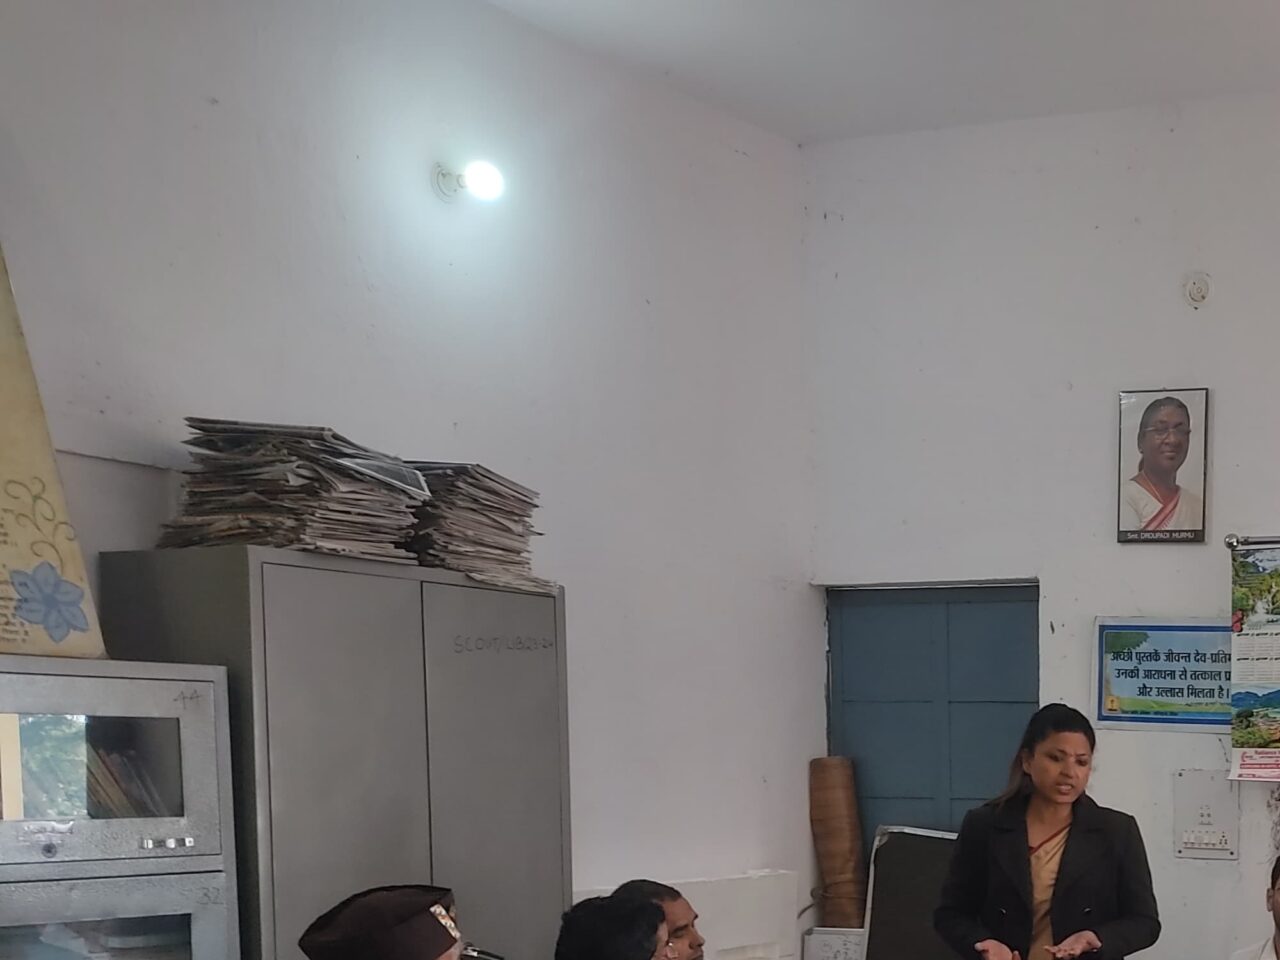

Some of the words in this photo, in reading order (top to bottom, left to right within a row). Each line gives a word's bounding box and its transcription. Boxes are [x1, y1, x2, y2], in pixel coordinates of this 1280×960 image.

[1172, 531, 1195, 539] MURMU
[1111, 649, 1133, 662] अच्छी
[1135, 649, 1161, 665] पुस्तकें
[1163, 649, 1191, 663] जीवन्त
[1115, 666, 1139, 679] उनकी
[1143, 670, 1176, 680] आराधना
[1179, 667, 1187, 680] से
[1190, 670, 1222, 681] तत्काल
[1137, 683, 1152, 697] और
[1155, 686, 1184, 698] उल्लास
[1187, 684, 1215, 698] मिलता
[198, 887, 224, 905] 32
